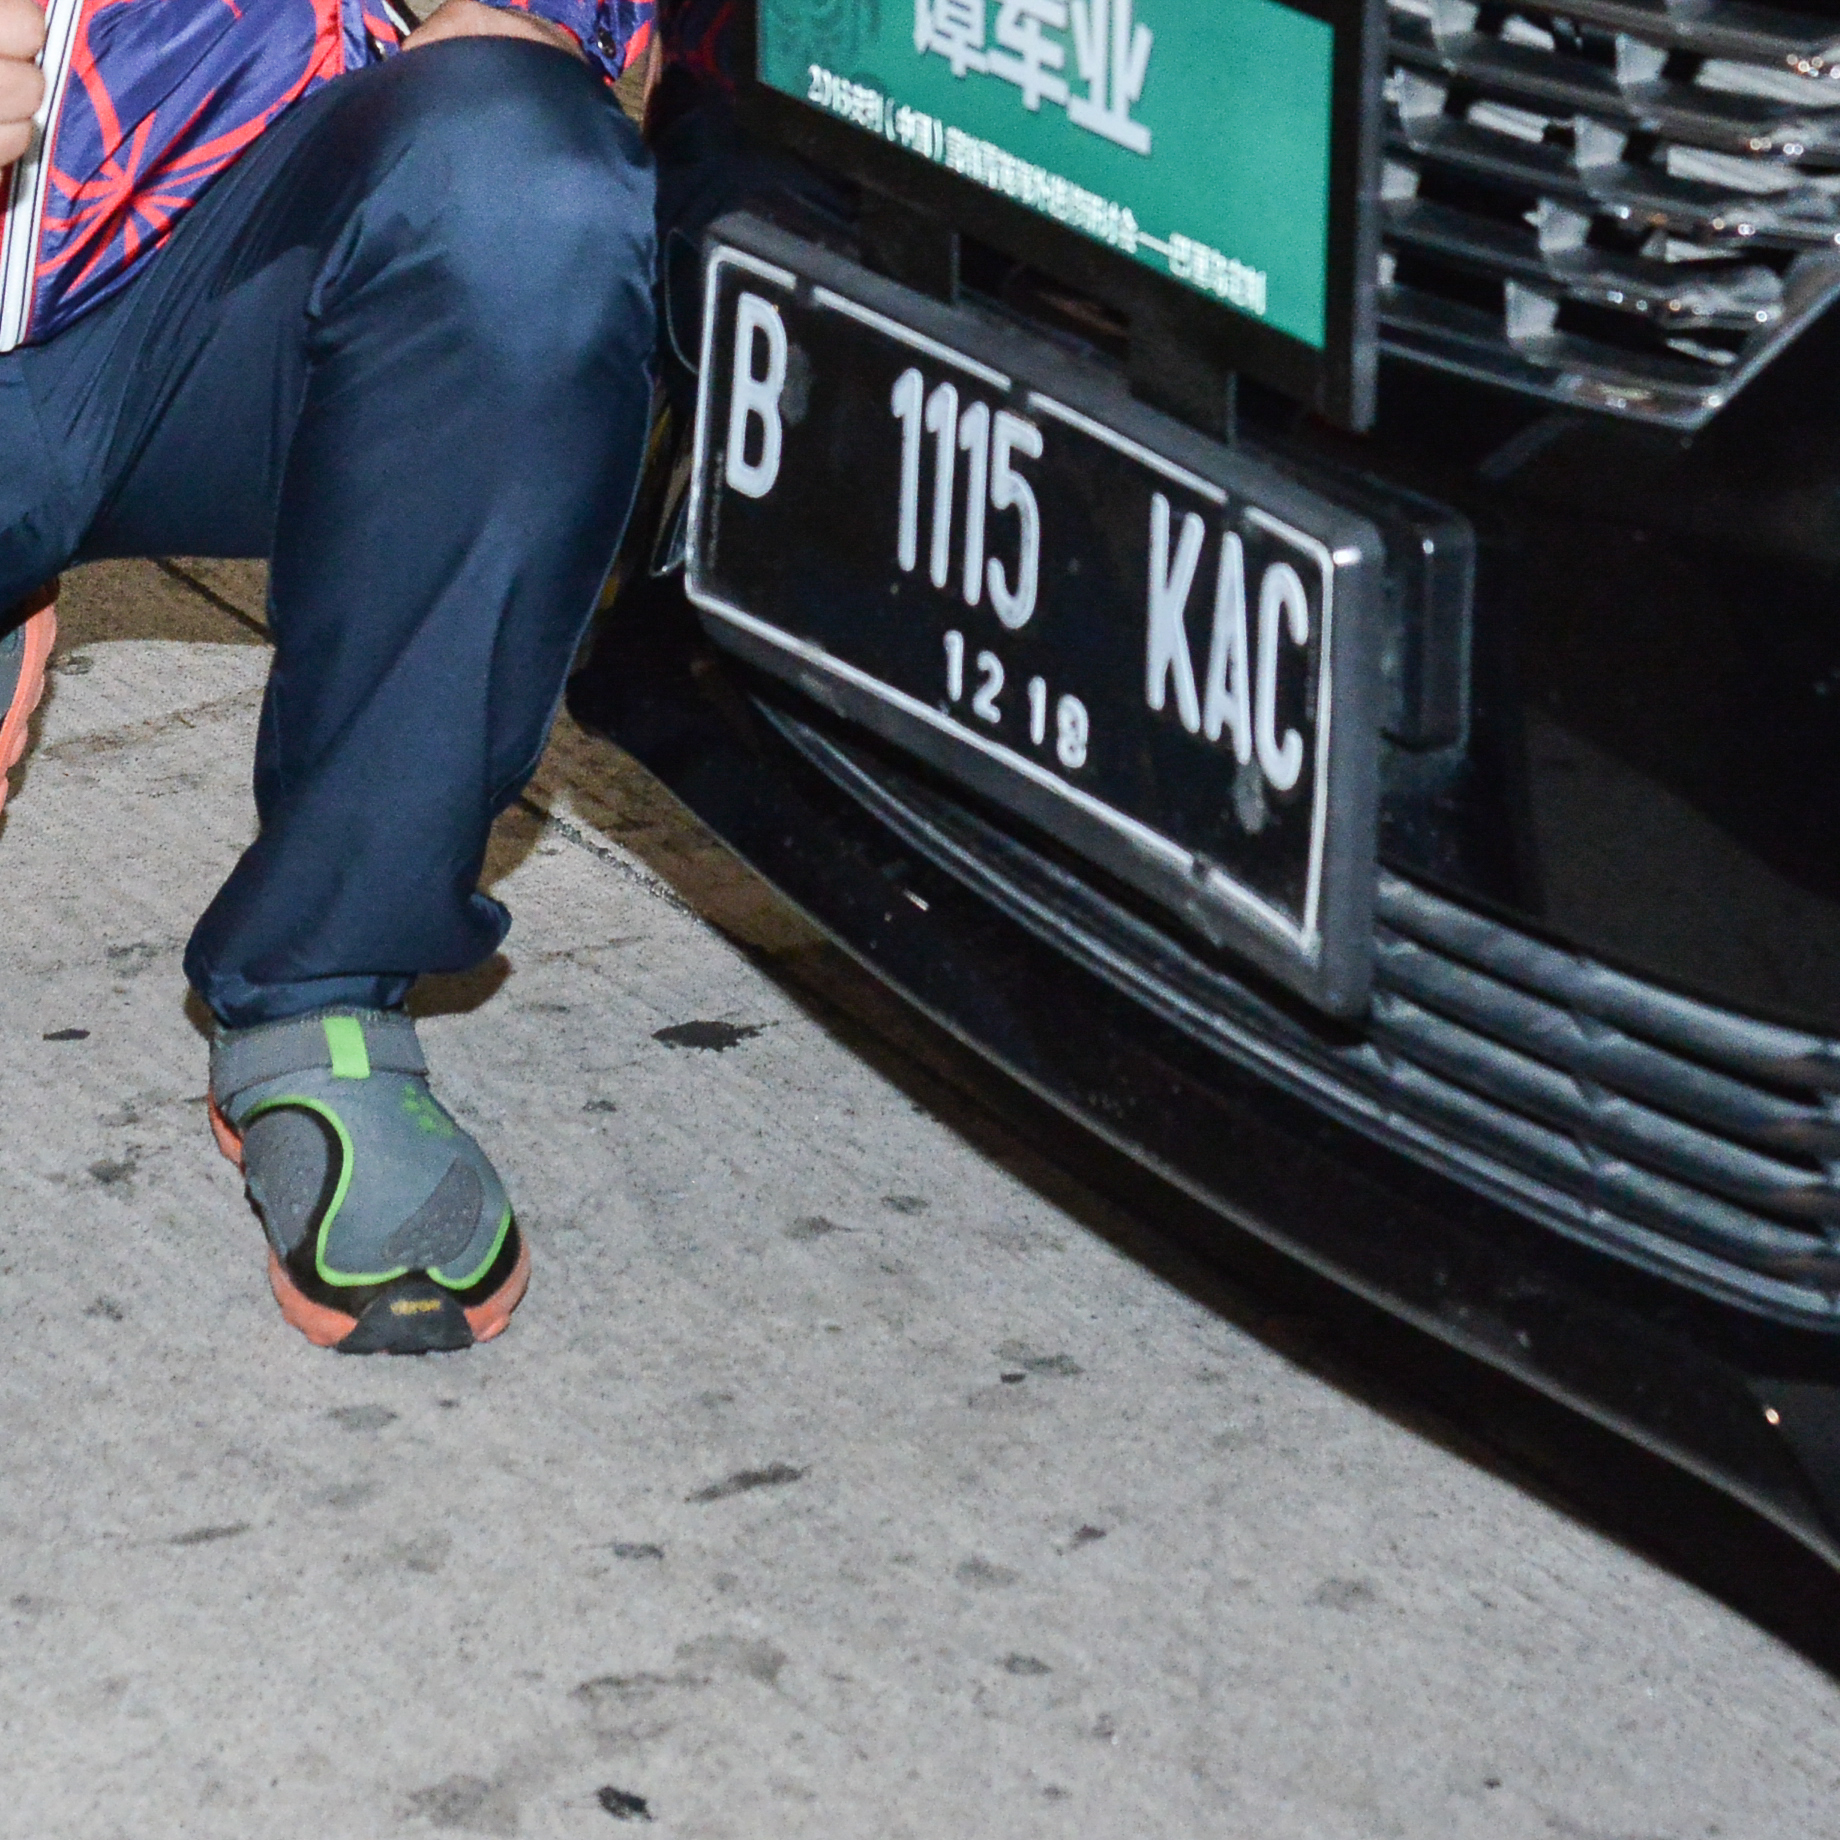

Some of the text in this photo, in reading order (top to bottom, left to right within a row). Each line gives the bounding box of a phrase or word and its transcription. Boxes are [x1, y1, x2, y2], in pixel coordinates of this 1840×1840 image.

[726, 293, 1309, 791] B 1115 KAC
[944, 630, 1004, 723] 12
